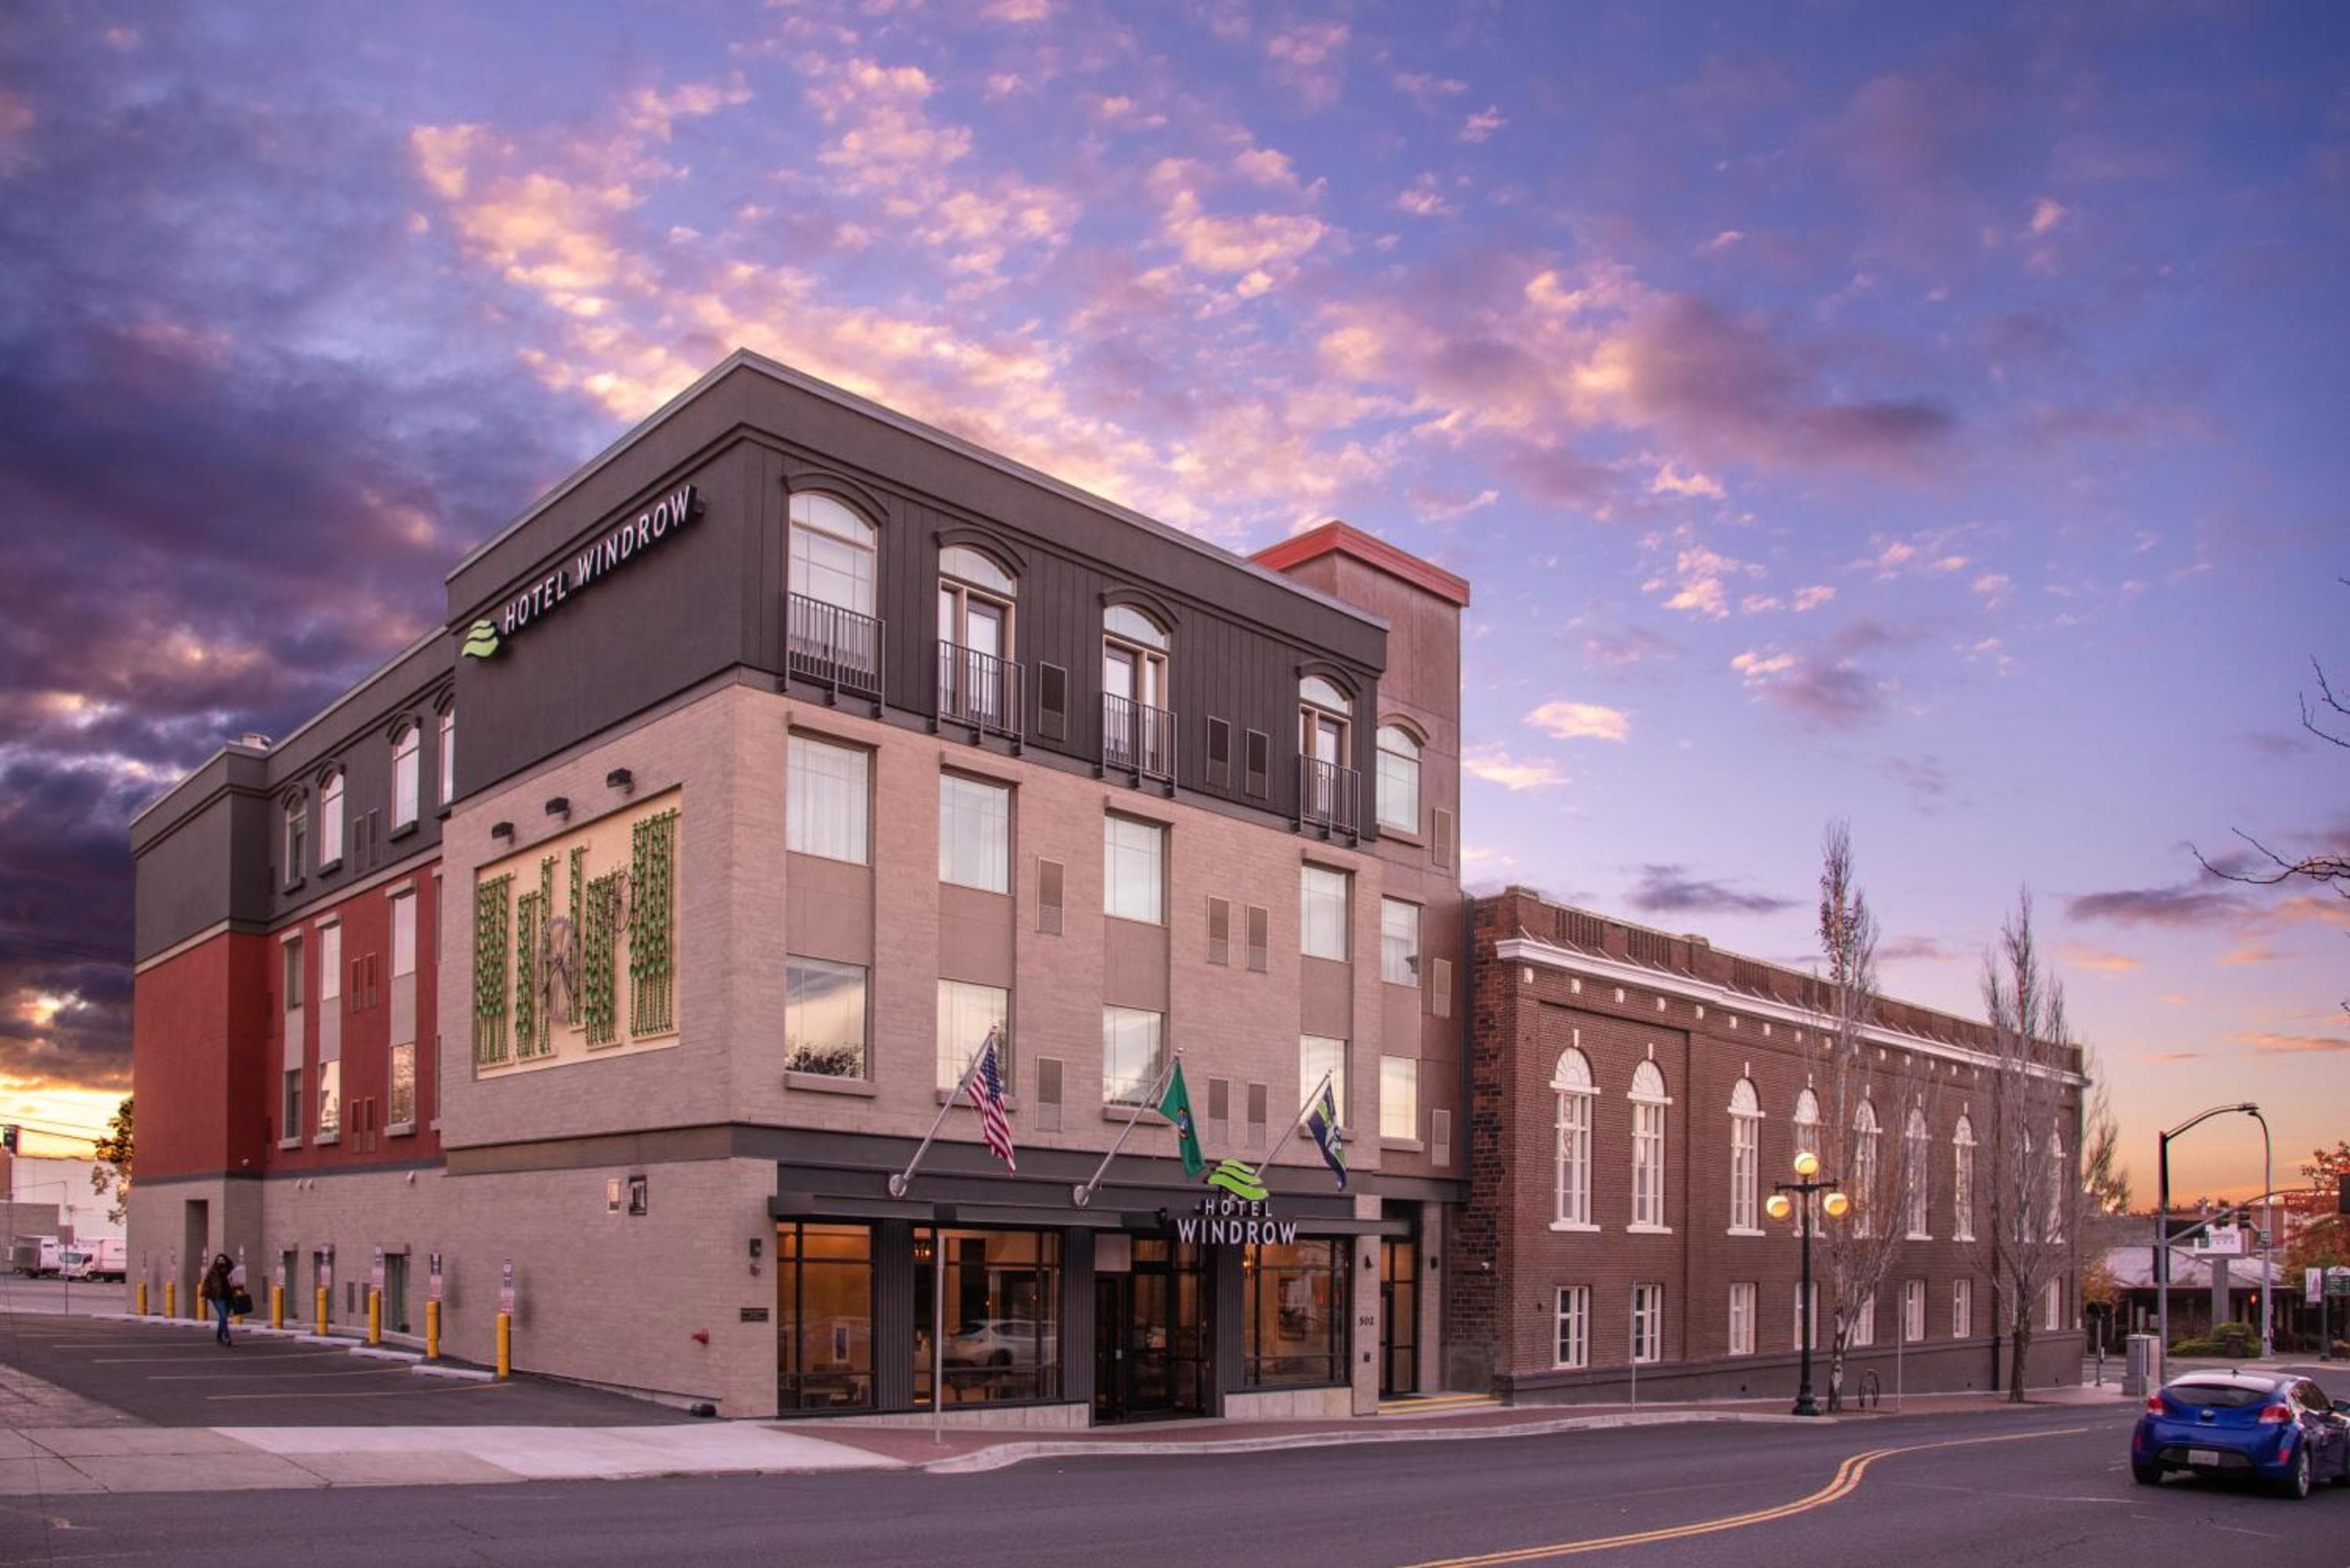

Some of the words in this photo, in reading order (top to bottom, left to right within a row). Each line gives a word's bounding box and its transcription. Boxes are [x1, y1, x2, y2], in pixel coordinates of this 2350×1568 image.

[504, 571, 566, 634] HOTEL
[577, 485, 691, 586] WINDROW
[1205, 1198, 1273, 1216] HOTEL
[1177, 1219, 1297, 1245] WINDROW
